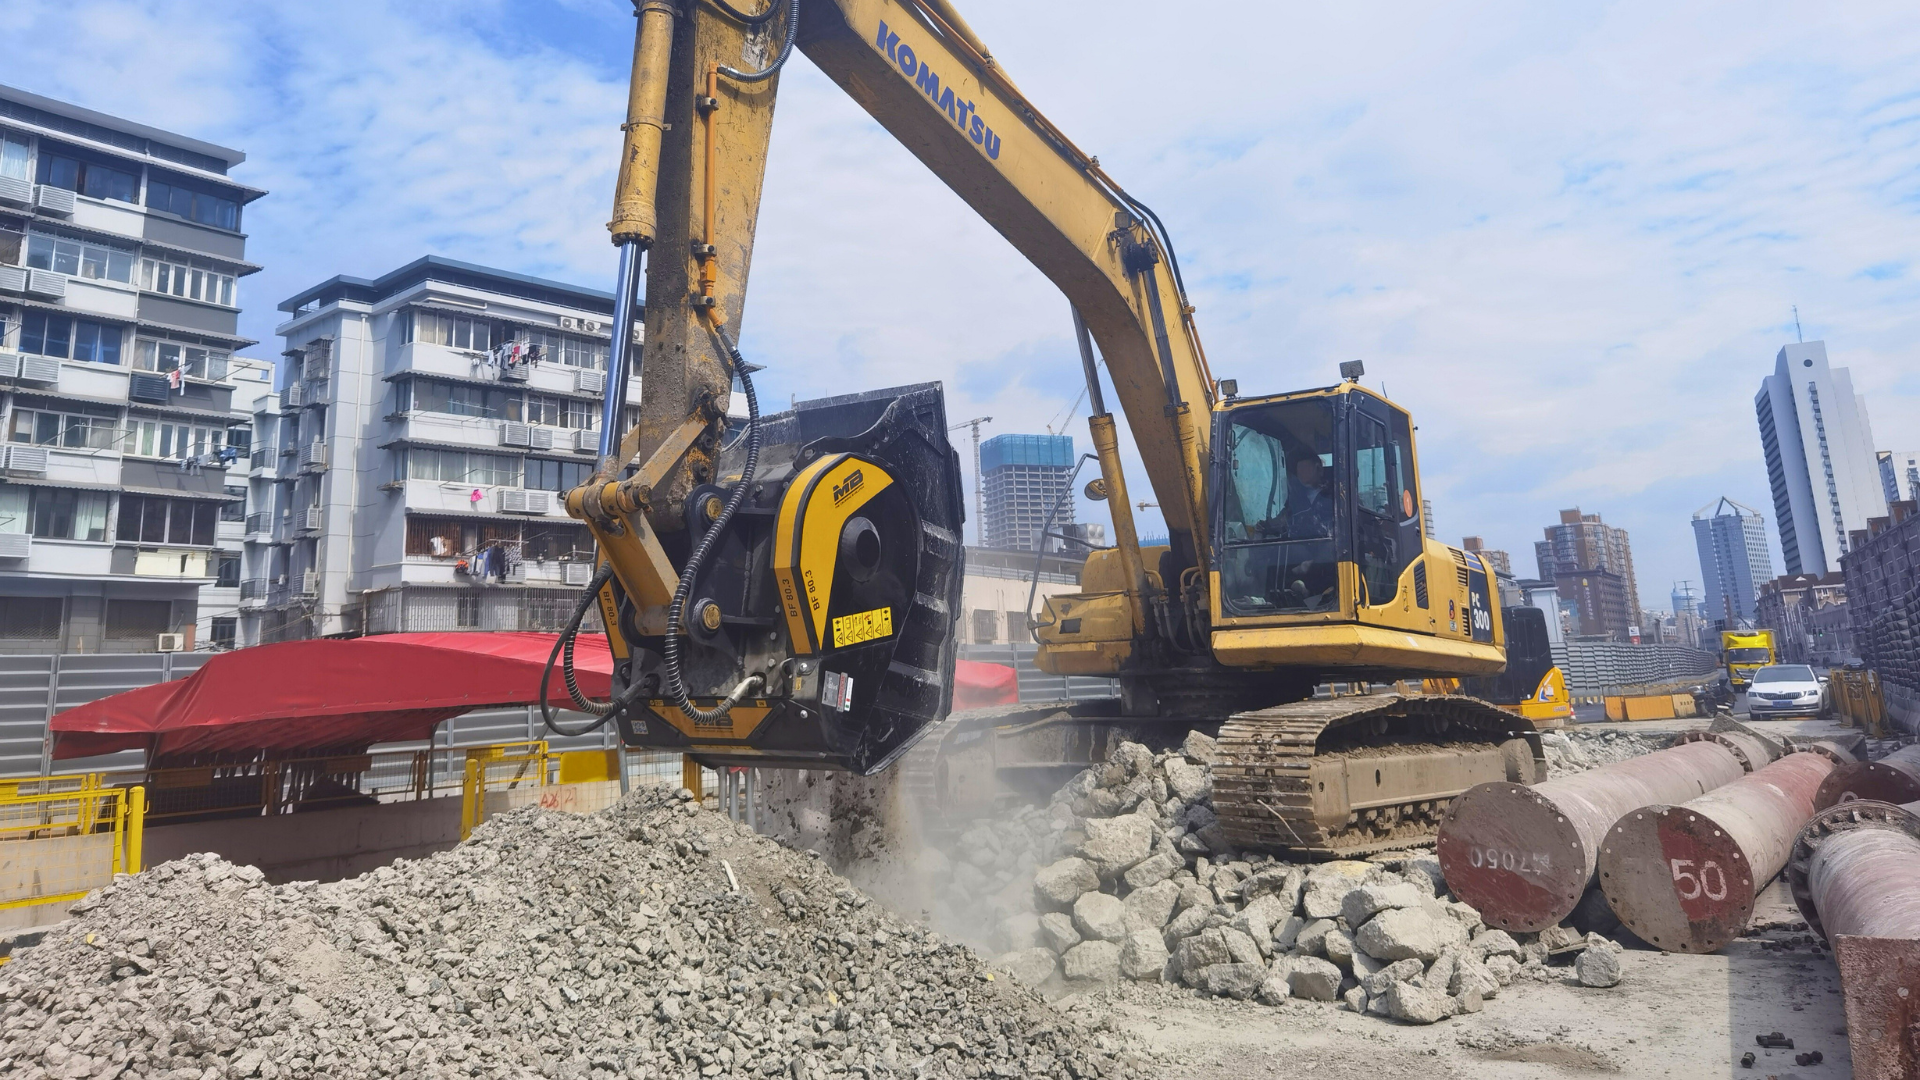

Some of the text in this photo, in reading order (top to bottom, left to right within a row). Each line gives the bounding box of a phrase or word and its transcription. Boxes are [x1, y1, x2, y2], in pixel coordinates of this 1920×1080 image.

[876, 19, 1001, 160] KOMATSU
[833, 469, 864, 502] MB
[783, 579, 797, 617] BF 80.3
[806, 570, 820, 610] BF 80.3
[1471, 592, 1481, 608] PC
[603, 591, 617, 626] BF 80.3
[1473, 608, 1490, 631] 300
[1670, 858, 1727, 901] 50
